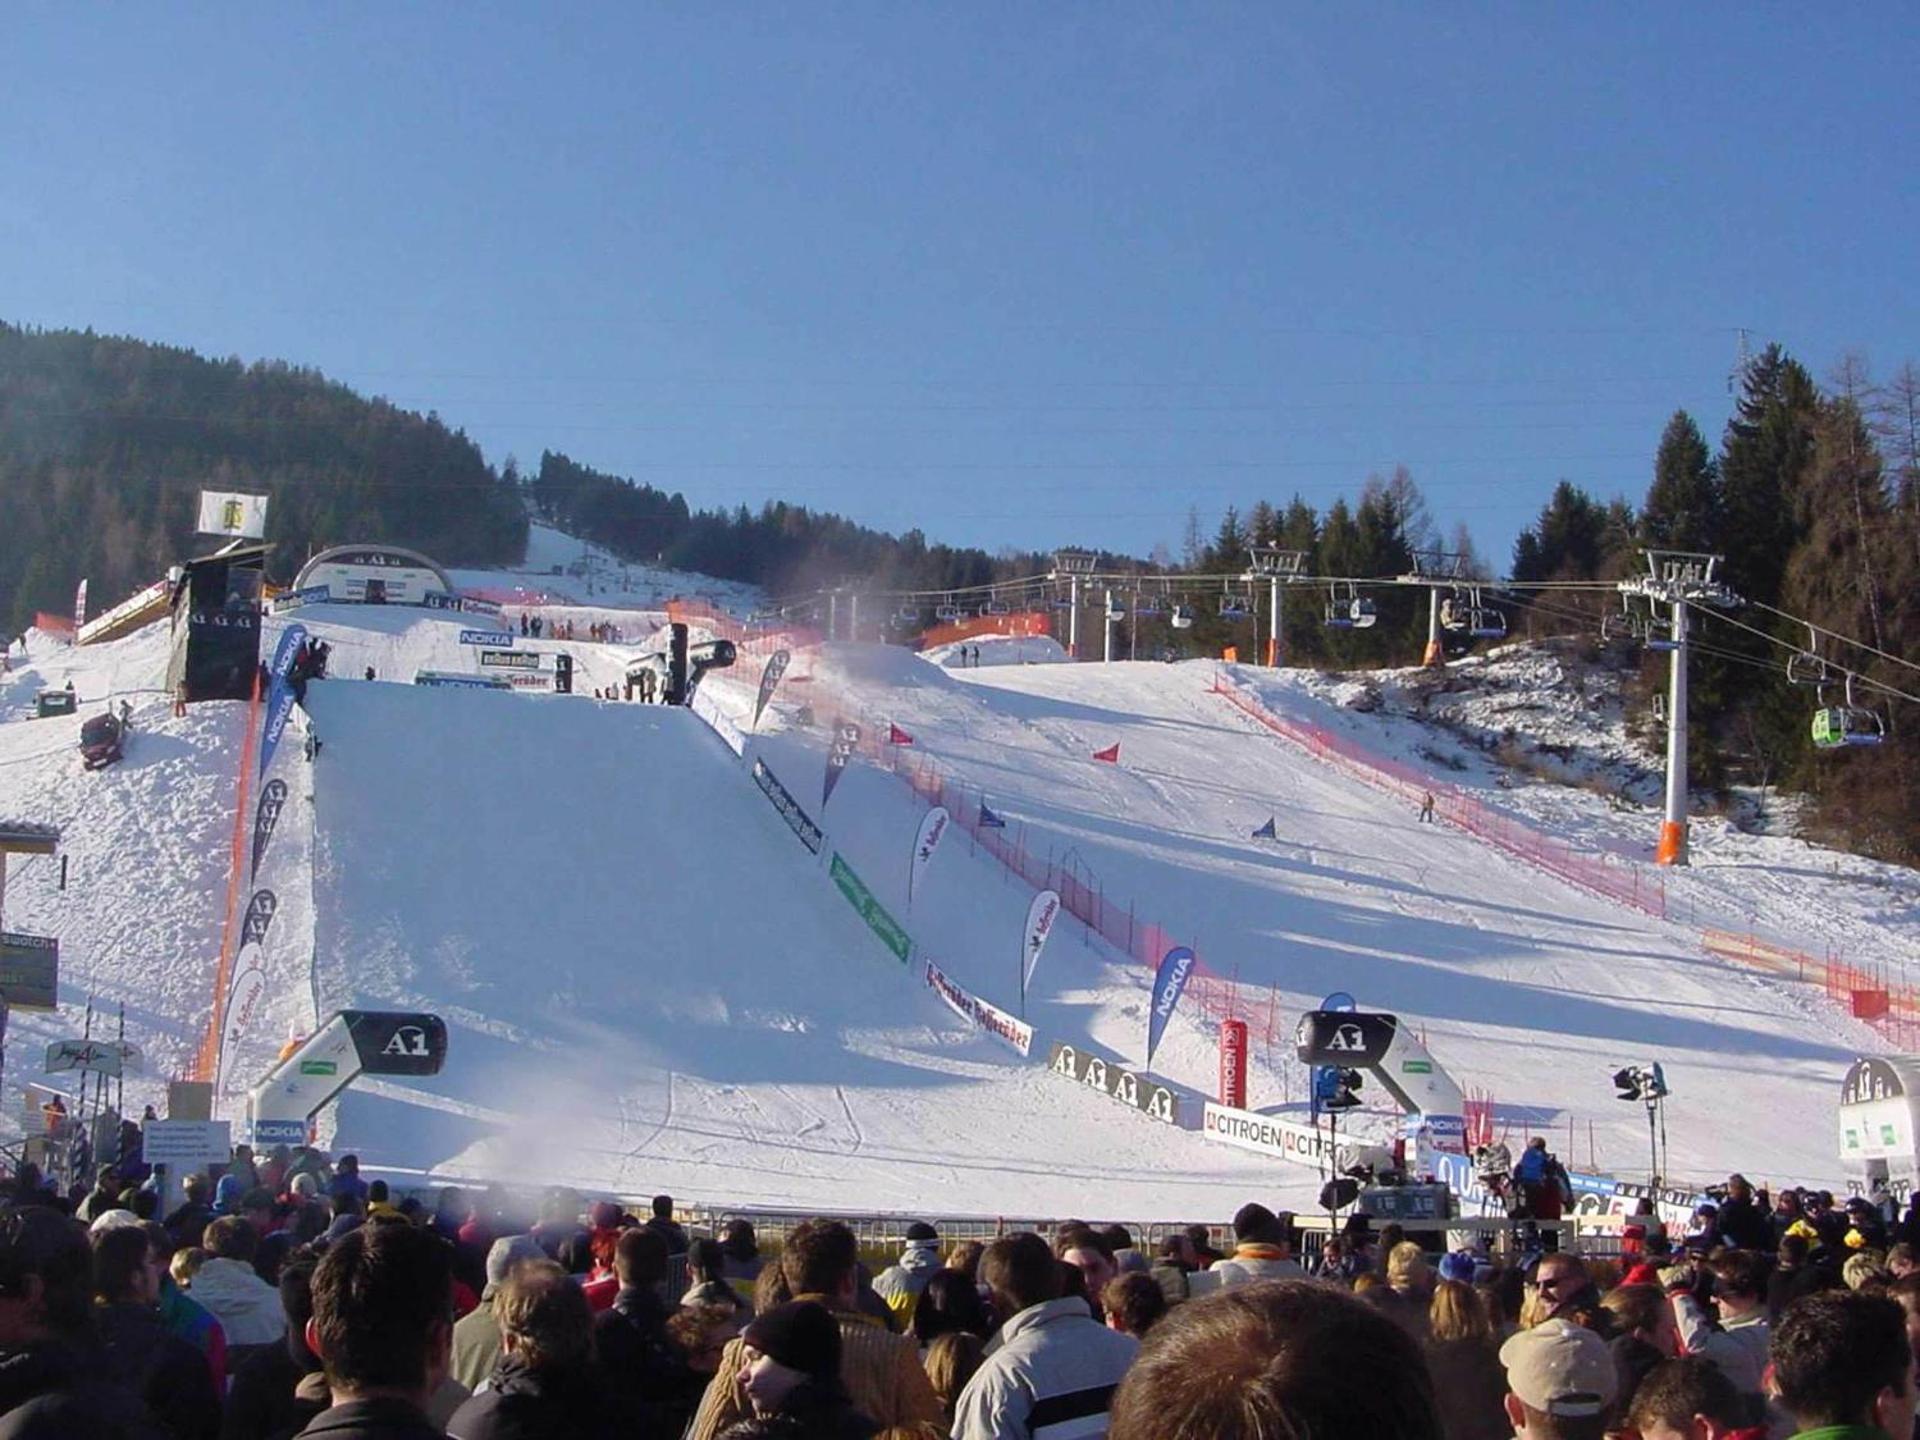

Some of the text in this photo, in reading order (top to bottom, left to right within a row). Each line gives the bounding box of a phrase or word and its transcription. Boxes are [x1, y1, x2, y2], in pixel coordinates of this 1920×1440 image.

[277, 631, 304, 676] NOKIA
[462, 632, 511, 645] NOKIA
[268, 695, 294, 742] NOKIA
[2, 935, 48, 949] swatch
[1157, 957, 1192, 1018] NOKIA
[381, 1025, 429, 1056] A1
[1324, 1023, 1367, 1051] A1
[1052, 1046, 1175, 1124] A1 A1 A1 A1
[255, 1126, 302, 1137] NOKIA
[1217, 1114, 1282, 1147] CITROEN
